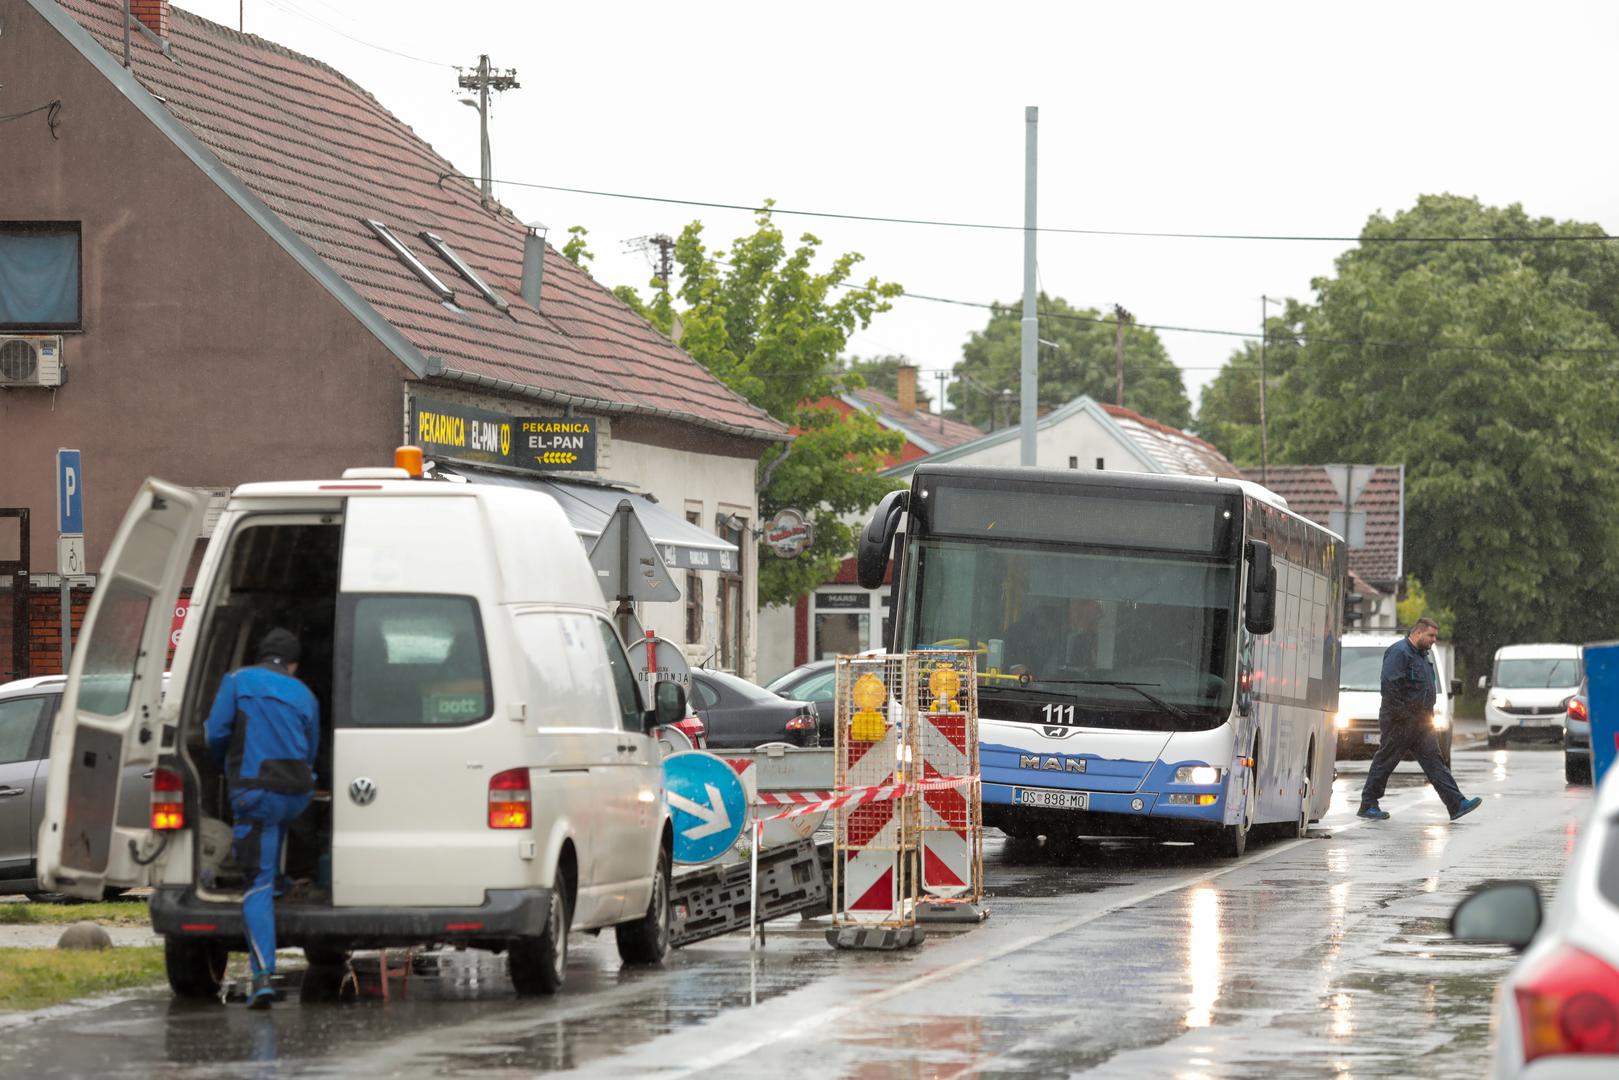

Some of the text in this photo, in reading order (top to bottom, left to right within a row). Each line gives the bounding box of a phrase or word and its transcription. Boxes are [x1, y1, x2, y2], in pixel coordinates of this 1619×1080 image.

[419, 411, 498, 452] PEKARNICA EL-PAN
[522, 423, 590, 433] PEKARNICA
[528, 436, 584, 449] EL-PAN
[65, 466, 76, 517] P
[1042, 703, 1075, 725] 111
[1019, 755, 1087, 774] MAN
[1022, 791, 1085, 808] OS 898-MO
